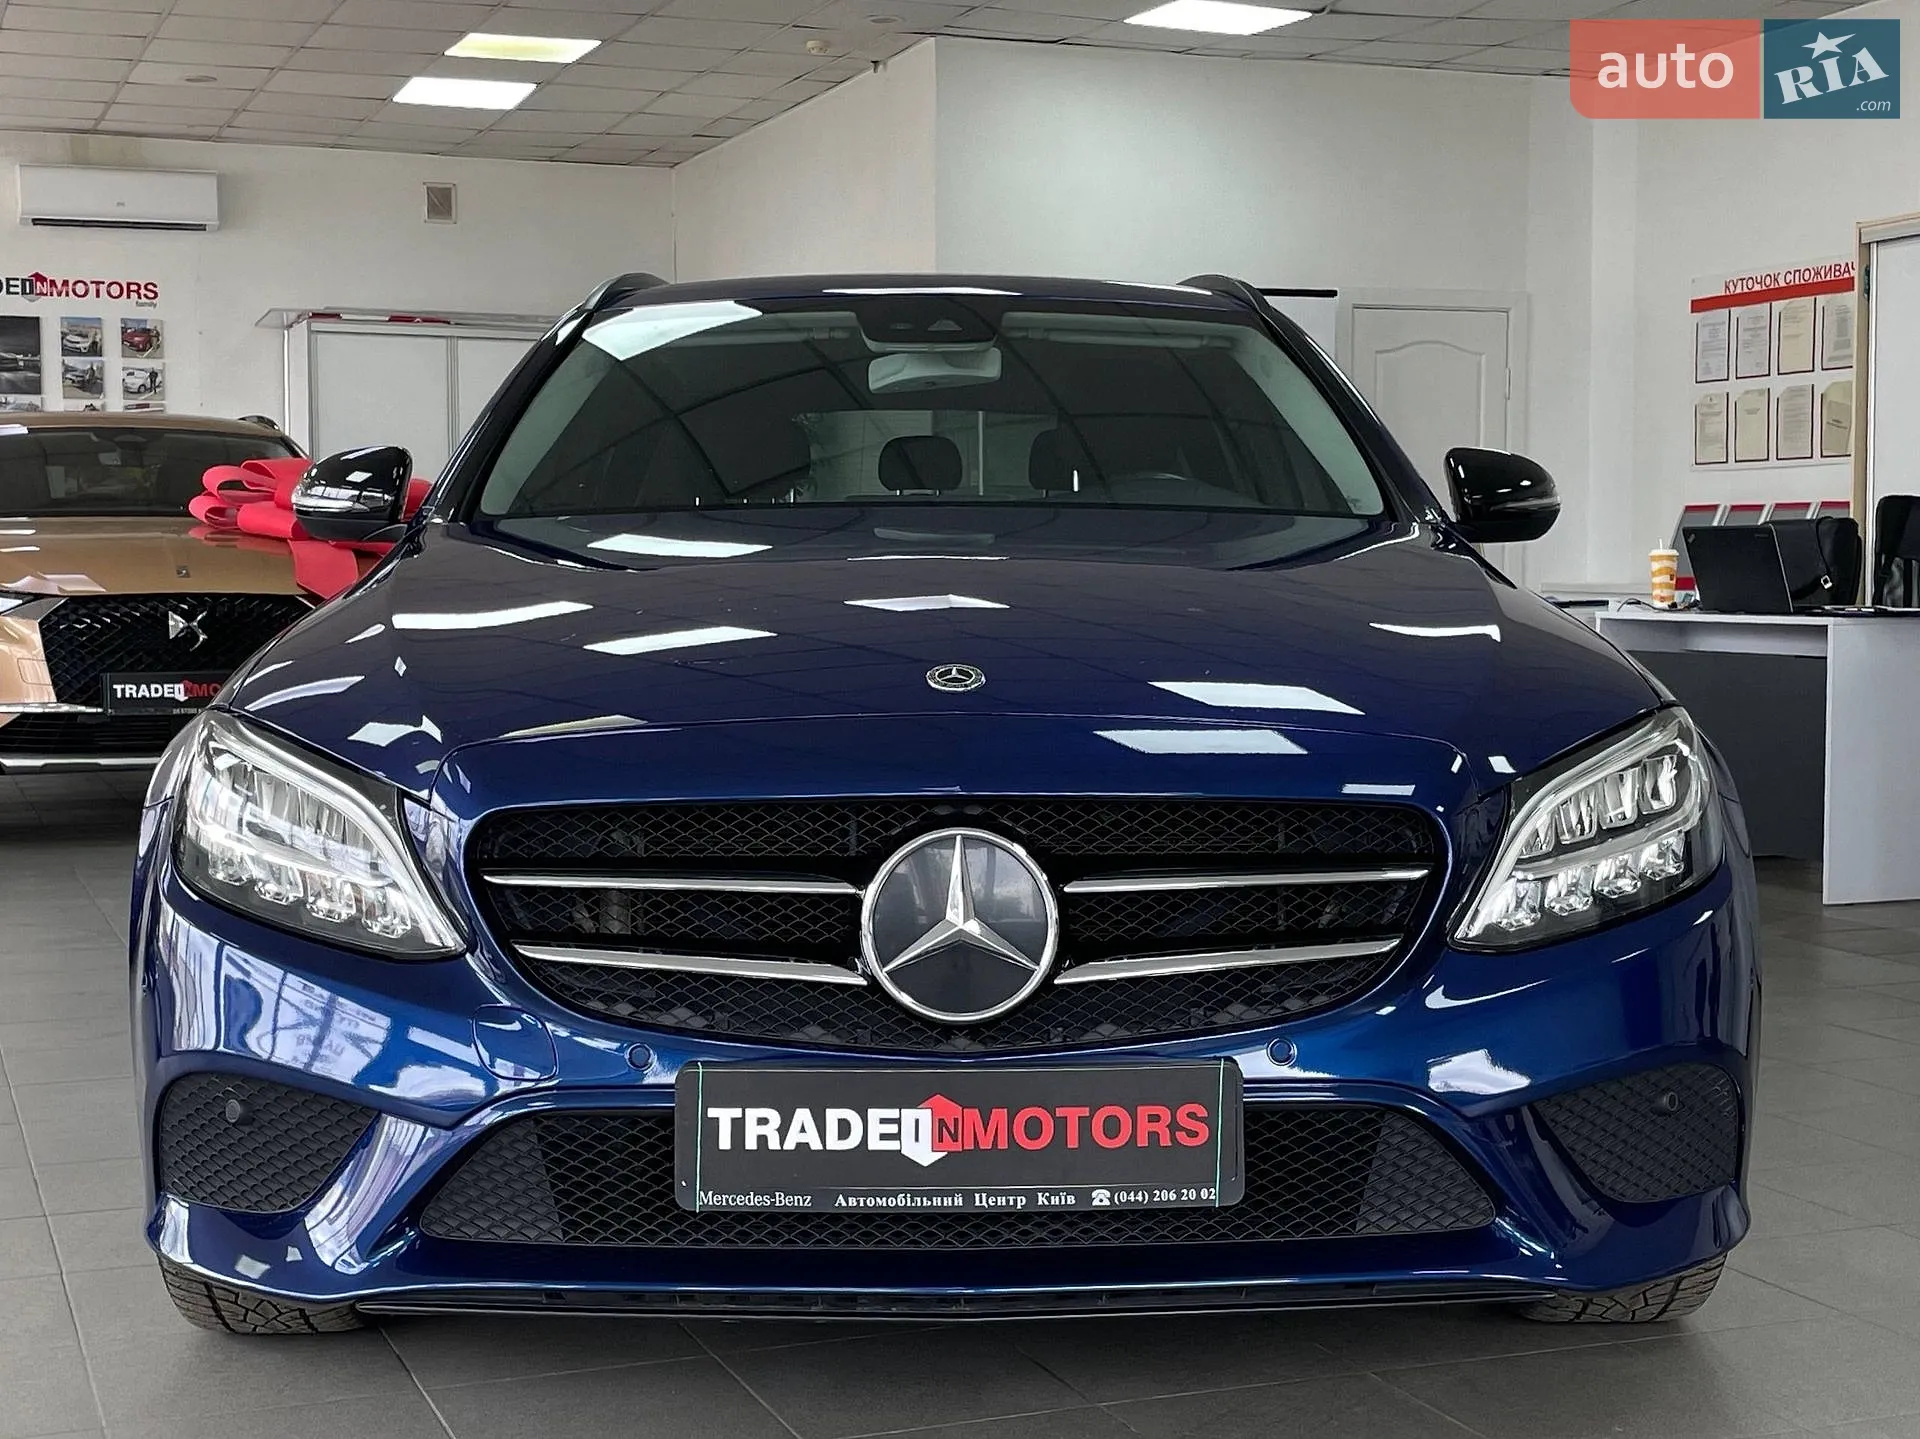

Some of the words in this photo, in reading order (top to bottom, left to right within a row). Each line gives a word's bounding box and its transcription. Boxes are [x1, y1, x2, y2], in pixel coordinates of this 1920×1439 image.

[1724, 271, 1781, 294] КУТОЧОК
[699, 1190, 812, 1207] Mercedes-Benz
[834, 1193, 964, 1208] Автомобільний
[974, 1192, 1027, 1209] Центр
[1037, 1191, 1076, 1206] Київ
[1114, 1189, 1149, 1205] (044)
[1153, 1189, 1177, 1202] 206
[1180, 1188, 1196, 1201] 20
[1200, 1187, 1216, 1200] 02
